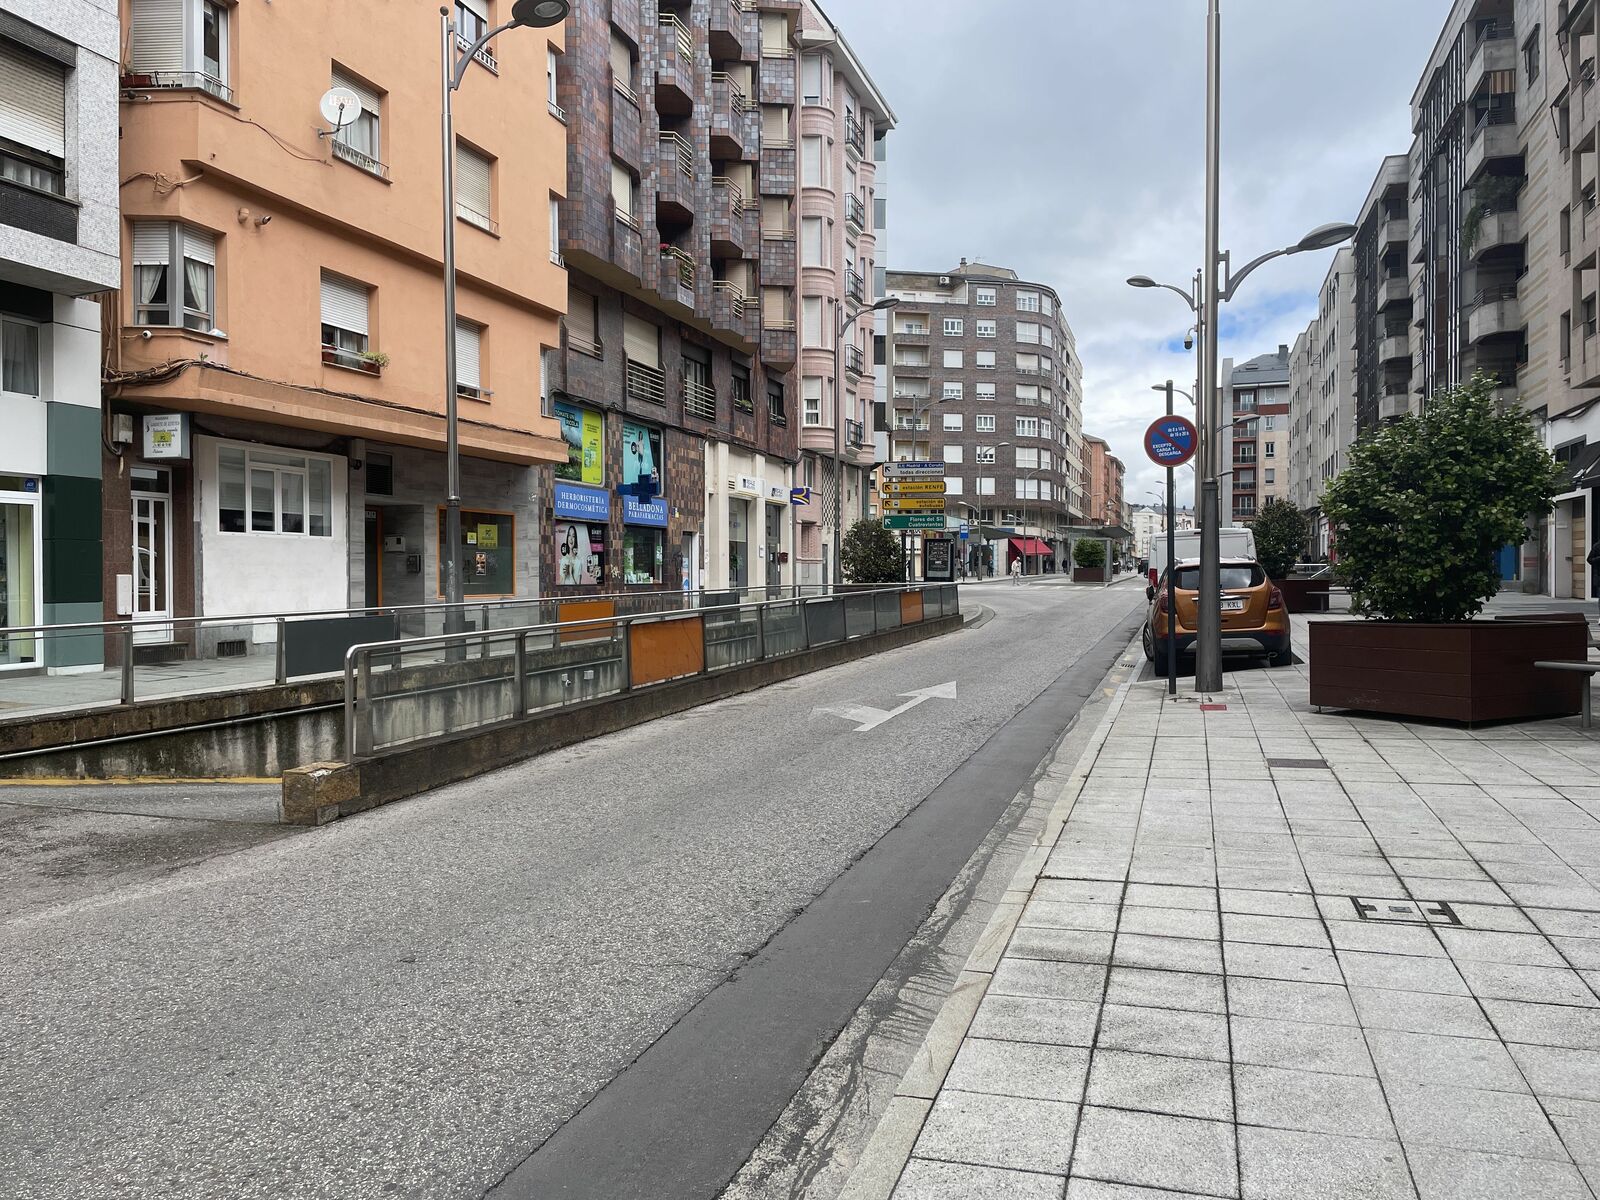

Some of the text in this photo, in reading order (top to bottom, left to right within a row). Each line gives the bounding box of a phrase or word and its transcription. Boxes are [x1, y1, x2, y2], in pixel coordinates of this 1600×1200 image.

[561, 492, 604, 504] HERBORISTERÍA
[557, 501, 607, 514] DERMOCOSMÉTICA
[628, 501, 664, 513] BELLADONA
[628, 512, 664, 520] PARAFARMACIAS
